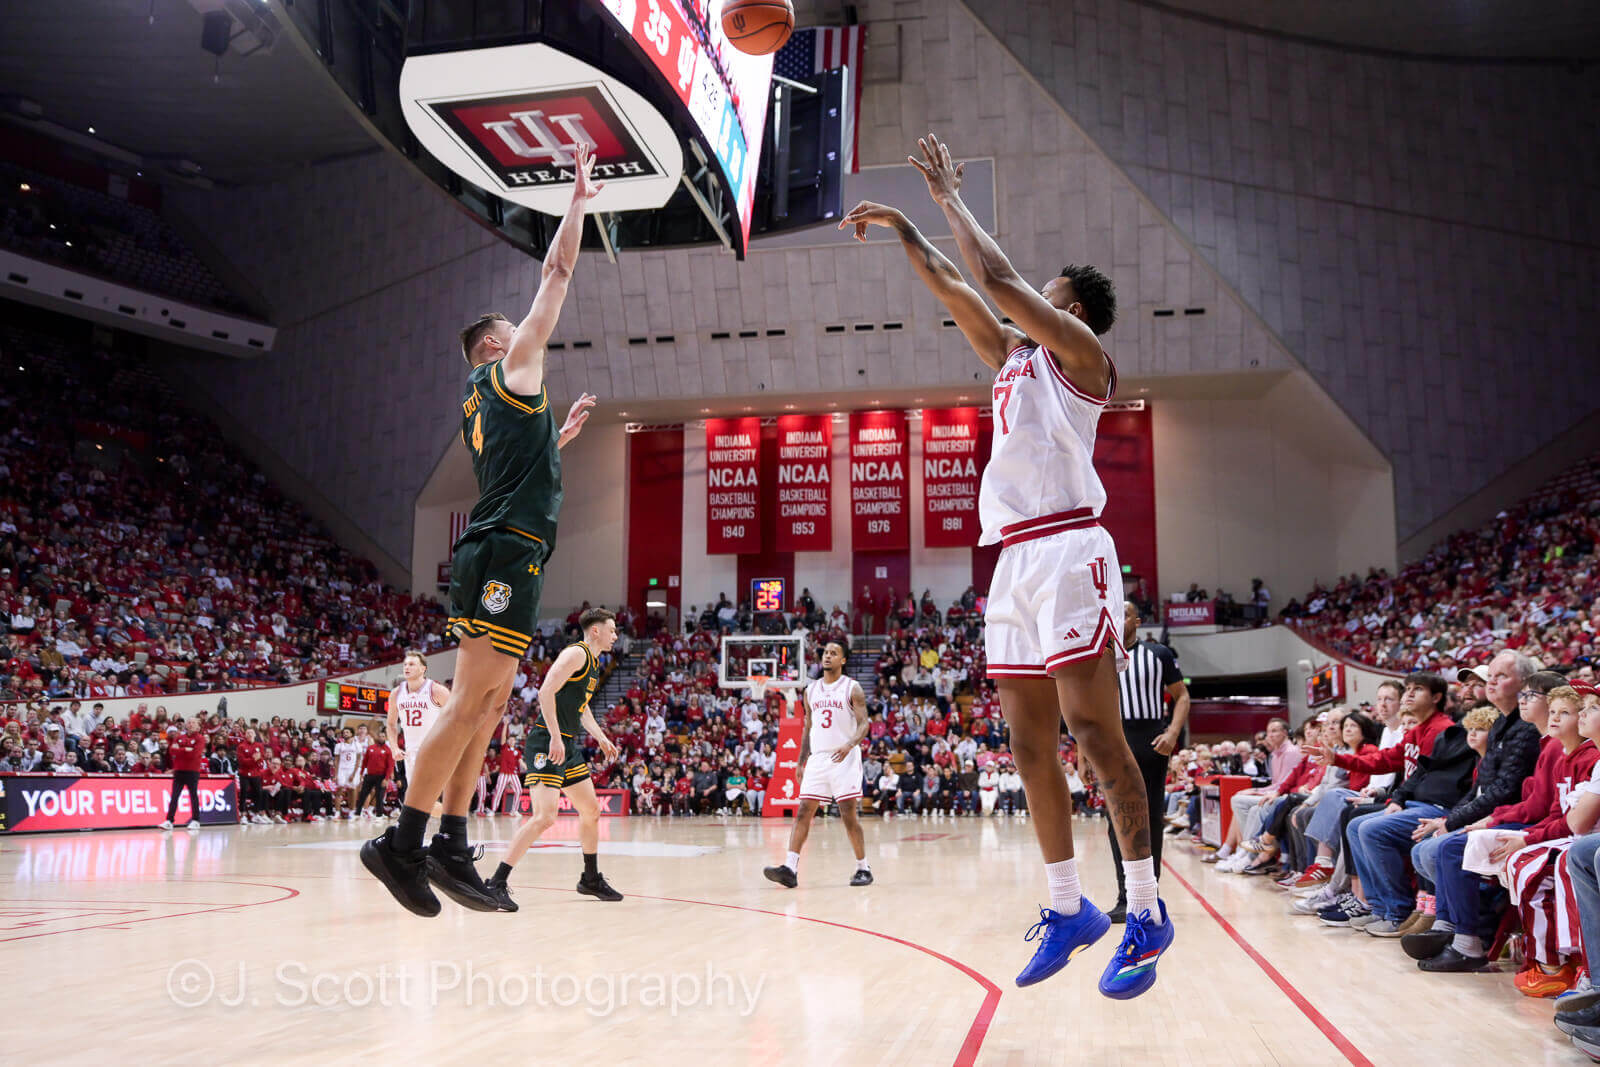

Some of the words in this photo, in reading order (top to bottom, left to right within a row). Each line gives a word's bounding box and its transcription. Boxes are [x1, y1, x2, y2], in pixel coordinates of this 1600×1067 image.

[643, 0, 672, 56] 35
[507, 161, 645, 185] HEATH
[994, 384, 1014, 435] 7
[472, 412, 484, 456] 4
[786, 431, 823, 444] INDIANA
[859, 427, 897, 442] INDIANA
[932, 424, 970, 438] INDIANA
[715, 434, 751, 448] INDIANA
[926, 439, 976, 453] UNIVERSITY
[710, 449, 757, 463] UNIVERSITY
[780, 446, 828, 459] UNIVERSITY
[853, 442, 903, 456] UNIVERSITY
[778, 464, 830, 484] NCAA
[851, 461, 904, 481] NCAA
[925, 458, 977, 478] NCAA
[709, 467, 758, 487] NCAA
[779, 488, 828, 502] BASKETBALL
[853, 486, 902, 499] BASKETBALL
[926, 483, 976, 496] BASKETBALL
[710, 492, 756, 505] BASKETBALL
[928, 498, 975, 512] CHAMPIONS
[711, 506, 755, 520] CHAMPIONS
[781, 504, 827, 517] CHAMPIONS
[855, 501, 901, 515] CHAMPIONS
[722, 525, 745, 538] 1940
[792, 522, 815, 535] 1953
[868, 520, 890, 533] 1976
[759, 581, 782, 592] 4:26
[757, 591, 780, 609] 25
[1169, 607, 1209, 618] INDIANA
[813, 700, 843, 712] INDIANA
[405, 709, 422, 727] 12
[821, 709, 832, 728] 3
[22, 790, 94, 817] YOUR
[102, 789, 158, 814] FUEL
[162, 789, 231, 813] NEDS.
